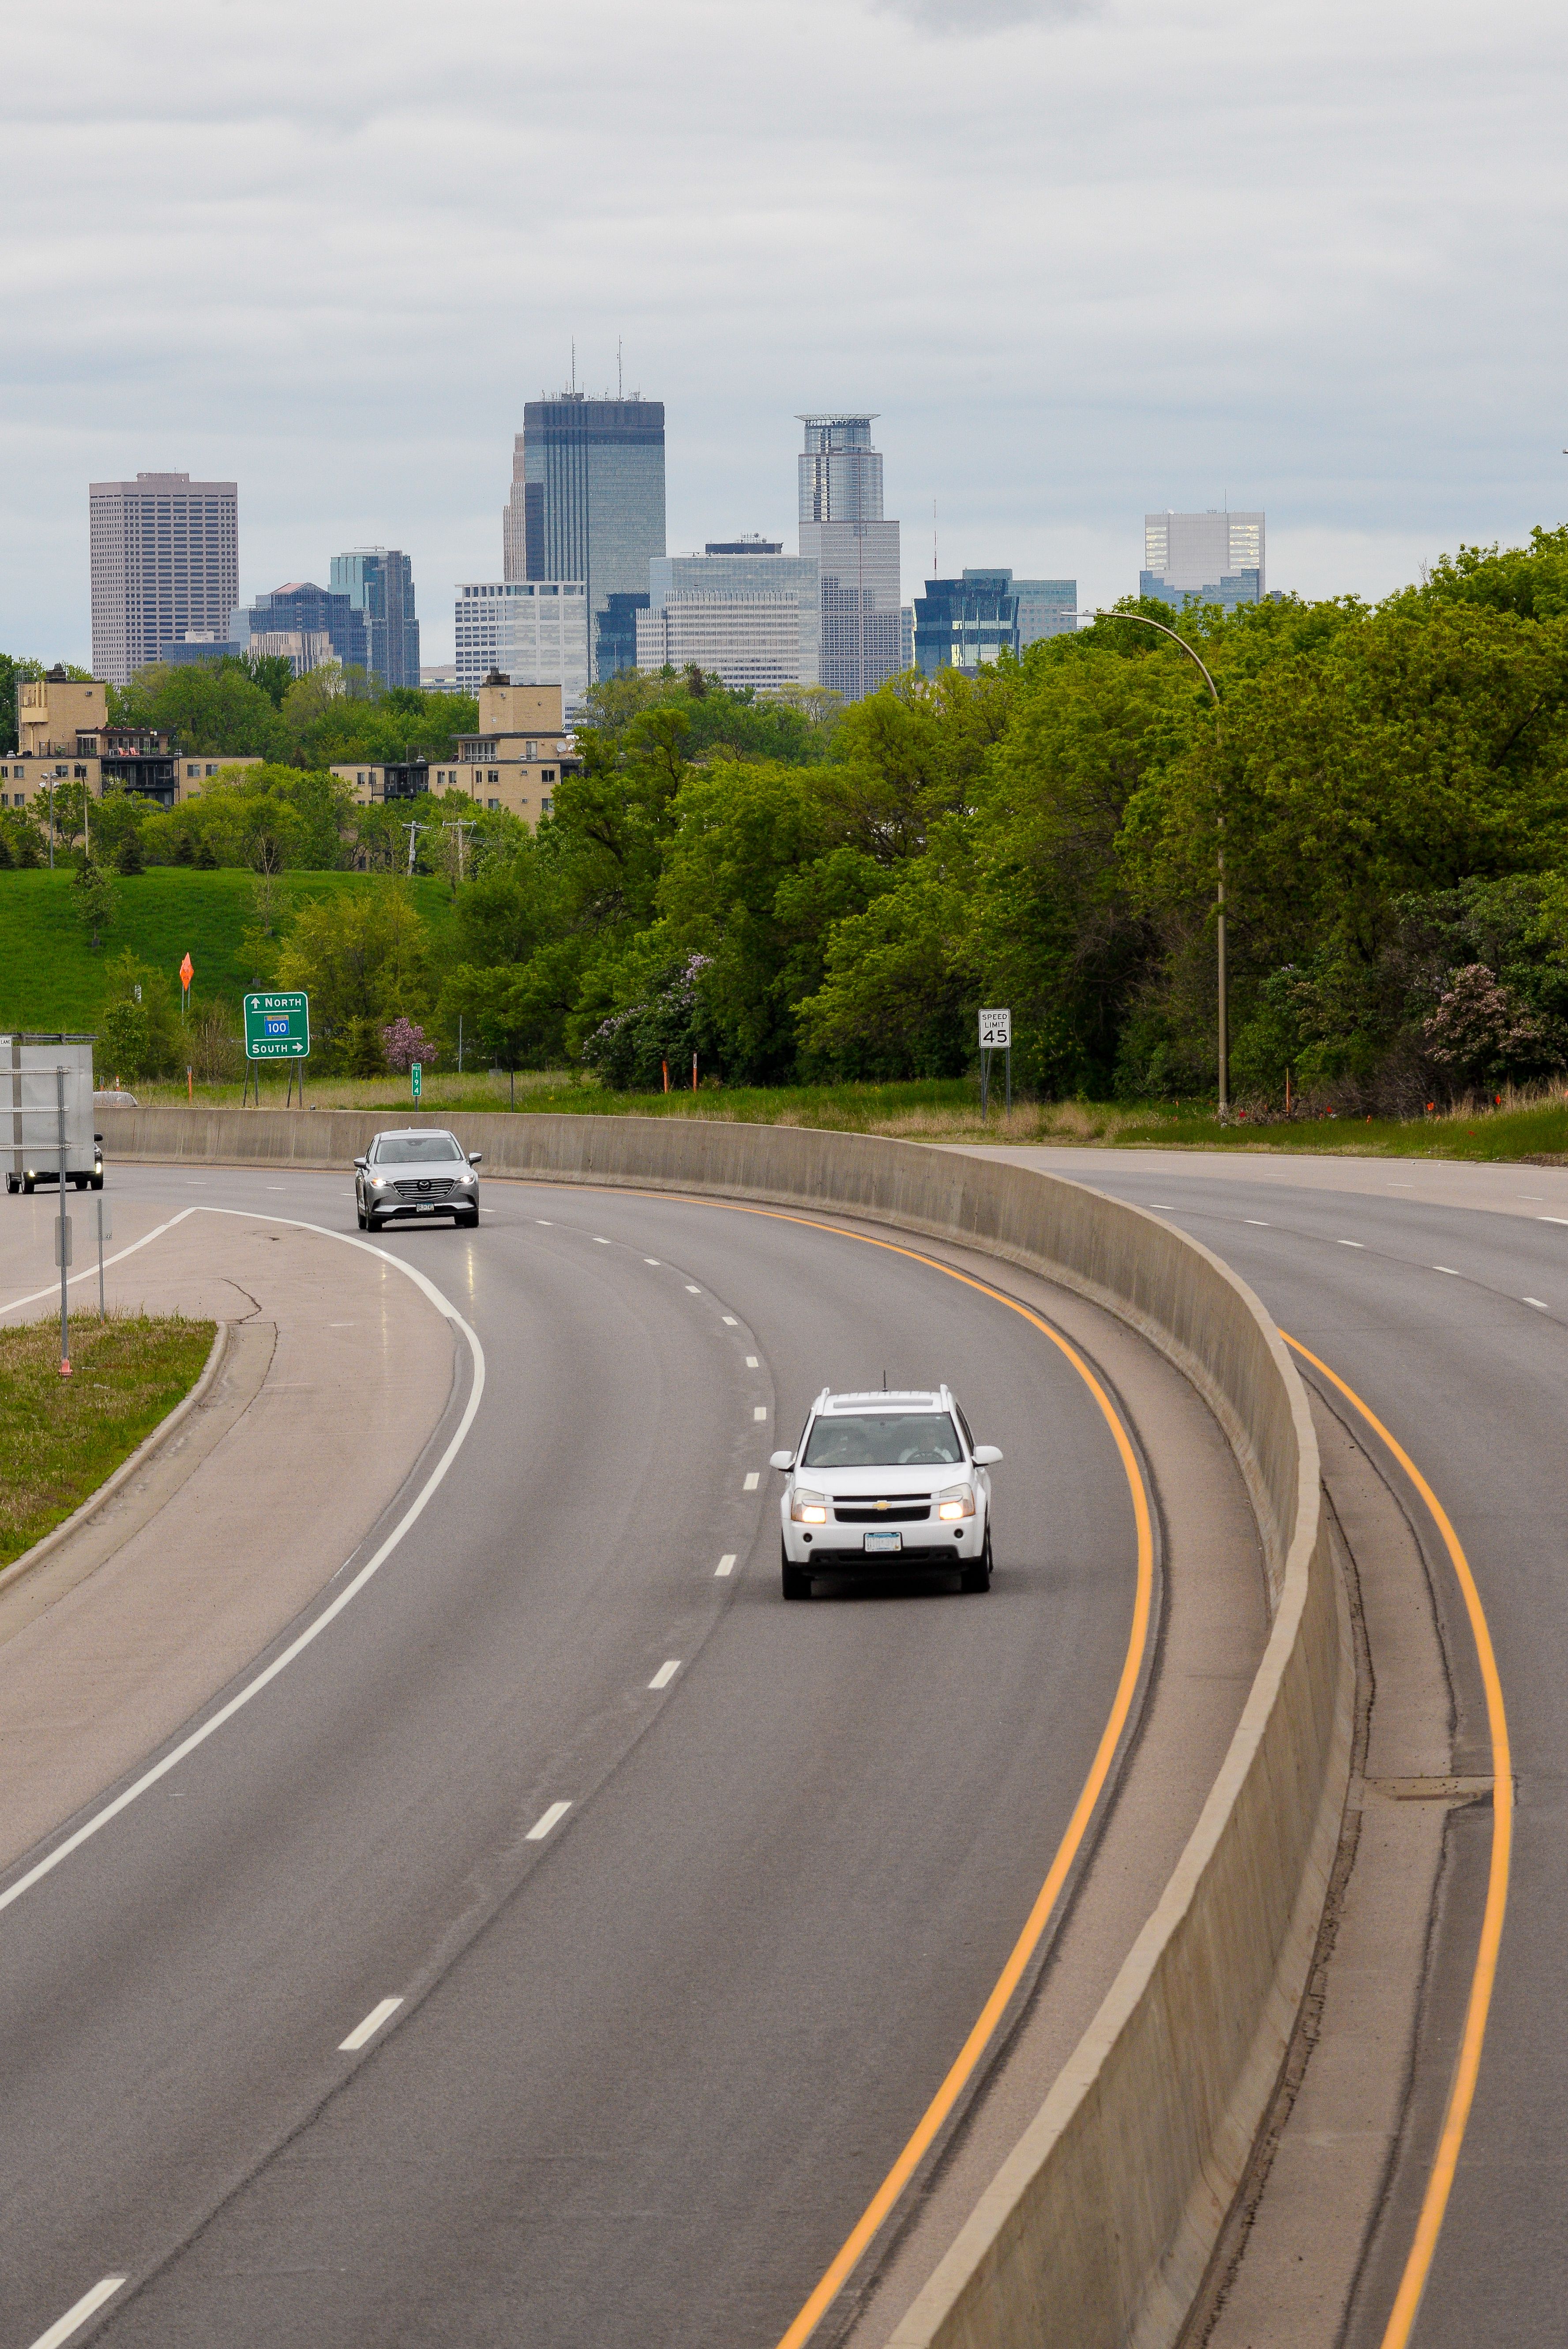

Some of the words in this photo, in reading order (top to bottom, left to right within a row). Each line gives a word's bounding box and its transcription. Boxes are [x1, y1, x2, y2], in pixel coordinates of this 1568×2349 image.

[265, 998, 301, 1007] NORTH
[268, 1023, 286, 1033] 100
[983, 1029, 1007, 1043] 45
[252, 1044, 287, 1054] SOUTH
